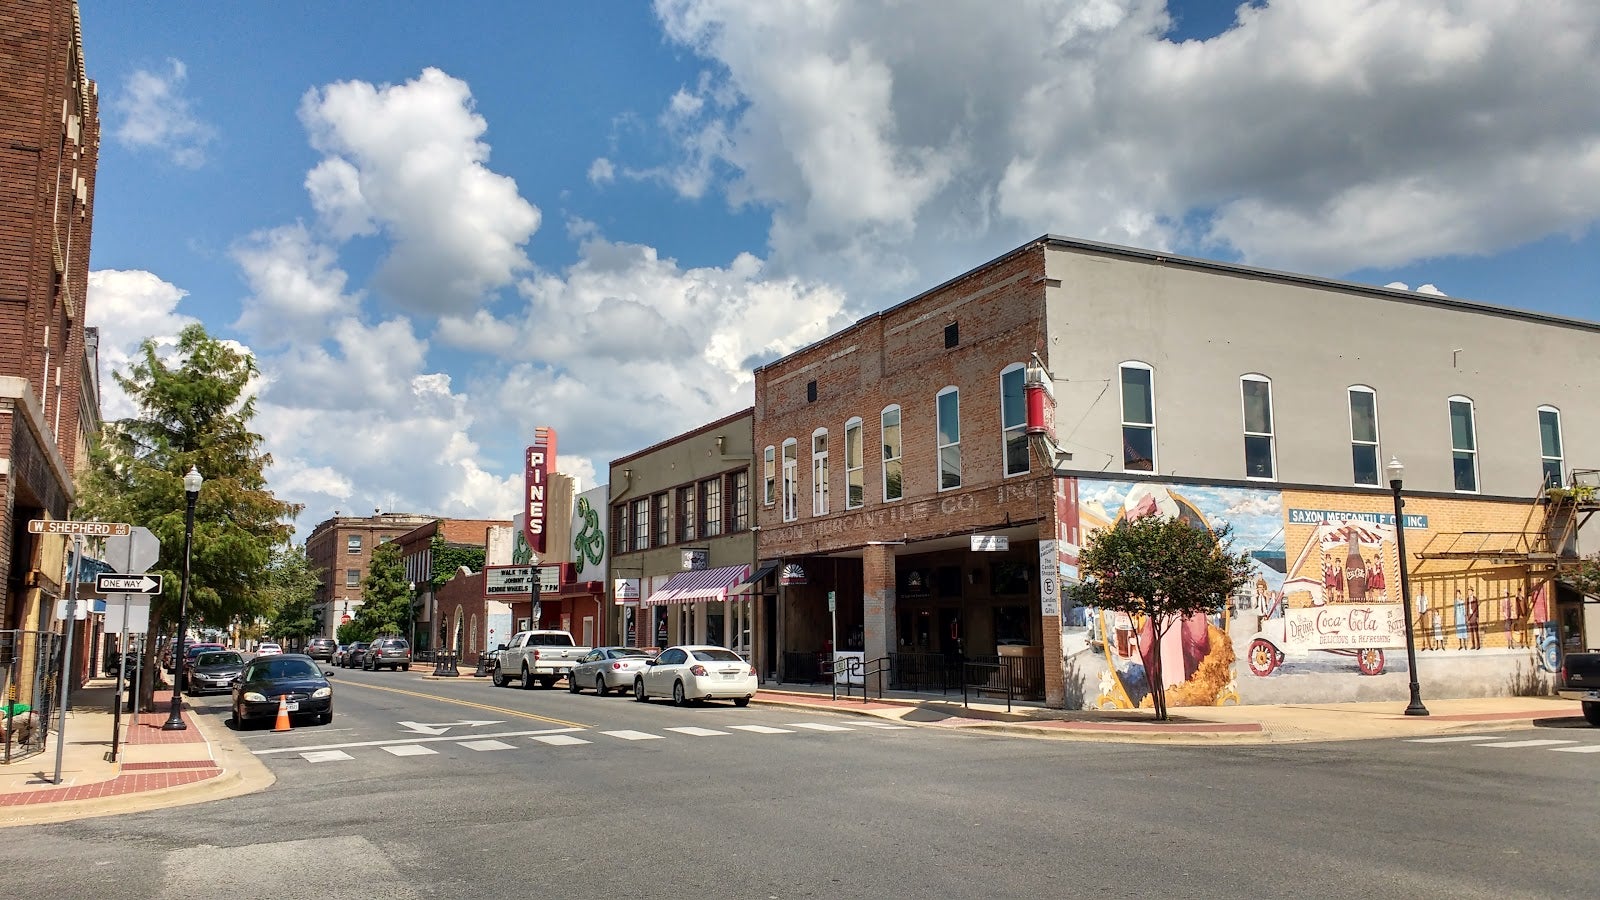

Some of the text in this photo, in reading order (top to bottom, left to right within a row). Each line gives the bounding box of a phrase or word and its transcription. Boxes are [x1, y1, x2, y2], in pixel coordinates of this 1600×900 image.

[530, 452, 544, 534] PINES
[1292, 510, 1324, 523] SAXON
[1326, 511, 1385, 524] MERCANTILE
[1407, 516, 1426, 527] INC.
[34, 522, 110, 534] W. SHEPHERD
[762, 525, 803, 544] SXON
[103, 580, 141, 588] ONE WAY
